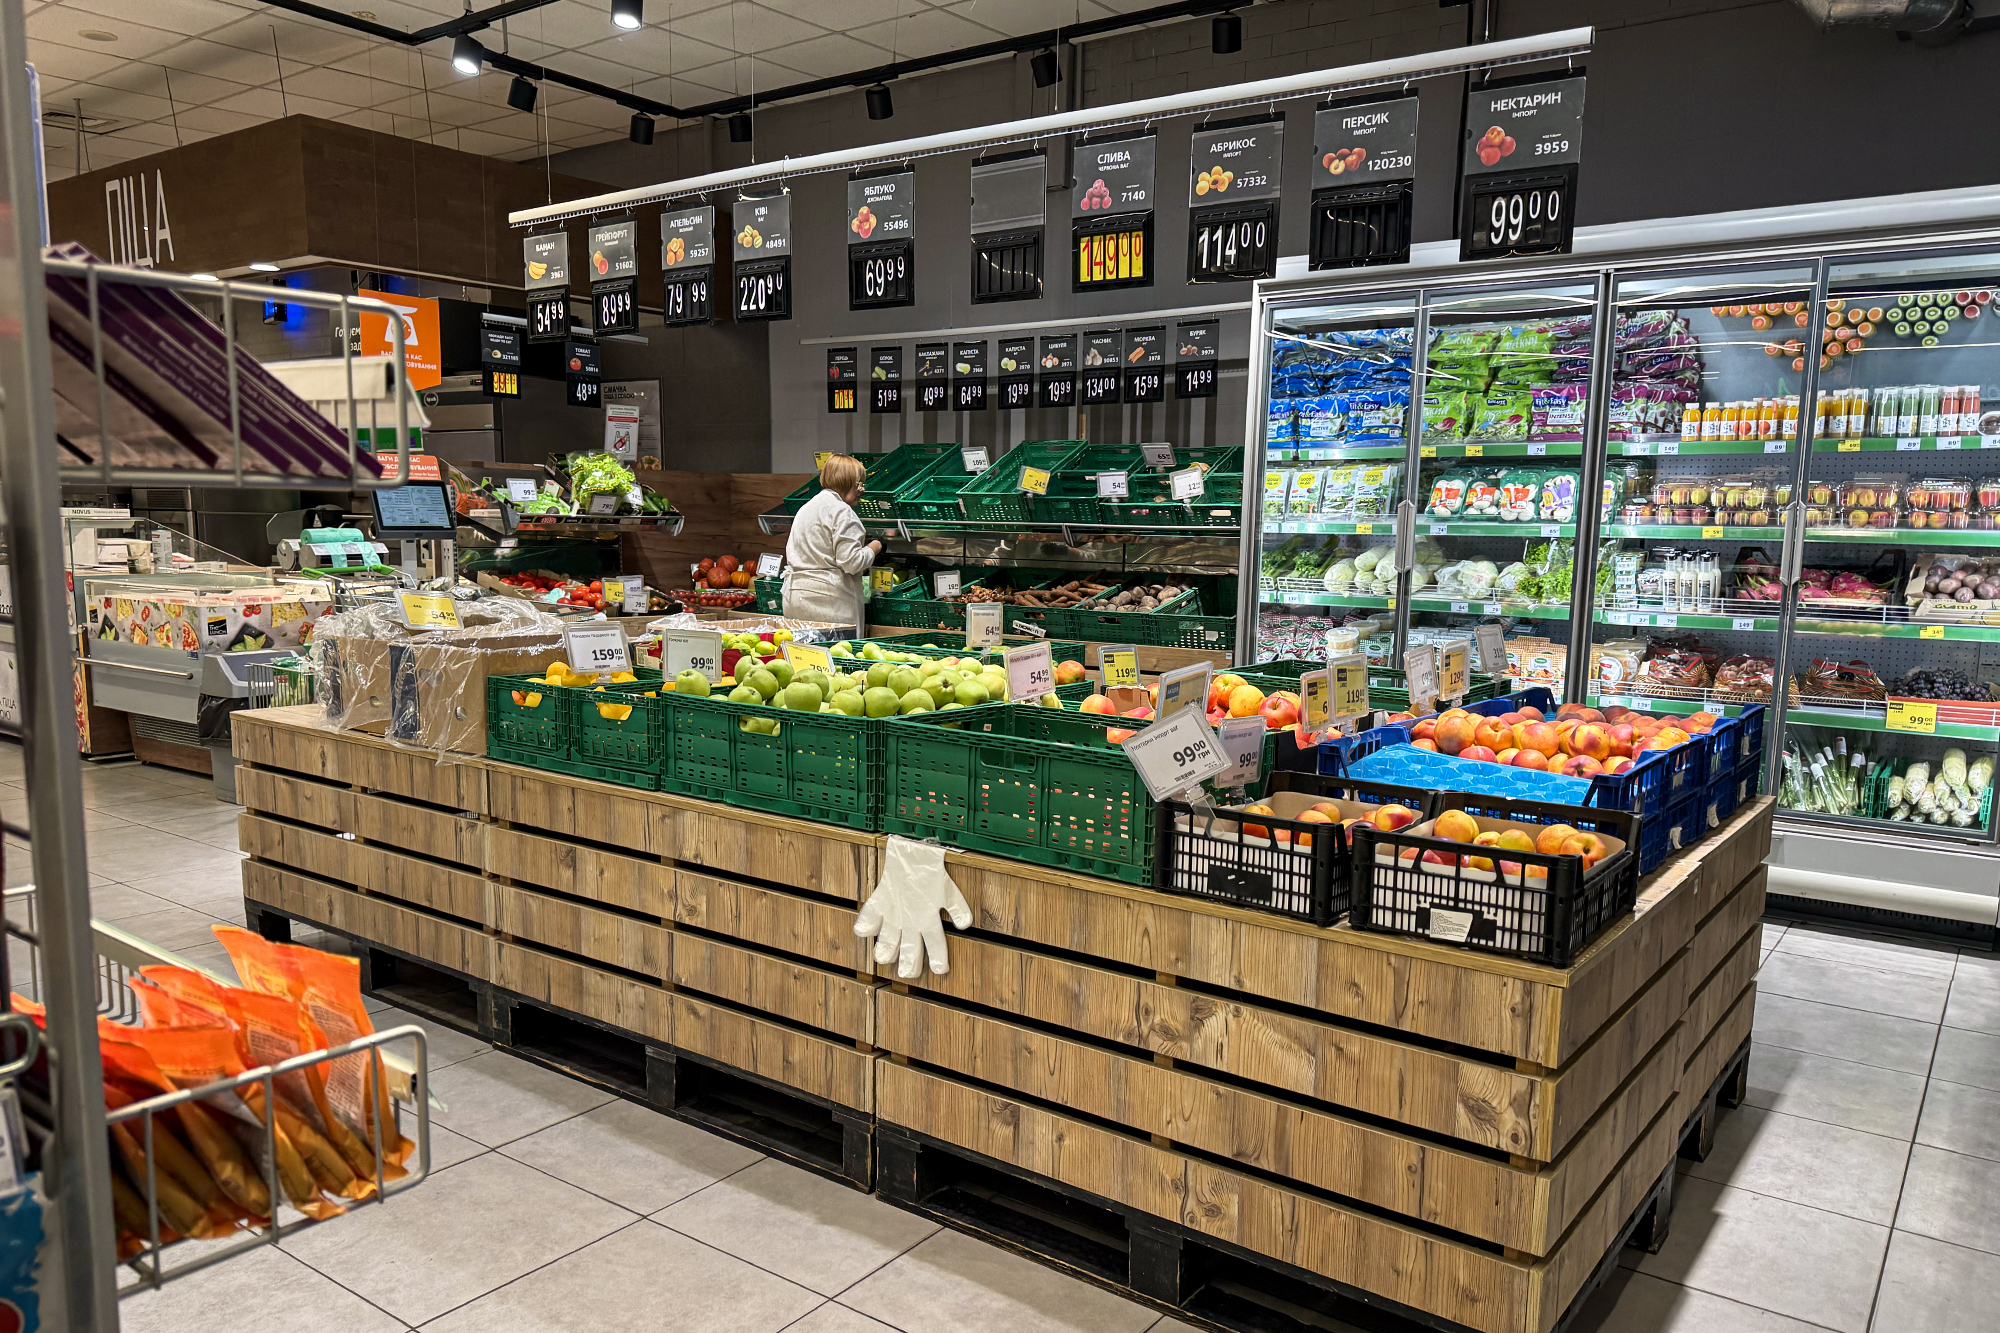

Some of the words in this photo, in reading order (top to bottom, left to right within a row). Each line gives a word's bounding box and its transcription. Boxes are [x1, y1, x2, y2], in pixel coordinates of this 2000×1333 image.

[1491, 92, 1562, 112] НЕКТАРИН
[1512, 109, 1537, 118] ІМПОРТ
[1343, 112, 1389, 129] ПЕРСИК
[1353, 127, 1376, 135] ІМПОРТ
[1210, 138, 1256, 153] АБРИКОС
[1534, 140, 1569, 155] 3959
[1097, 151, 1130, 164] СЛИВА
[1368, 155, 1412, 171] 120230
[1237, 176, 1266, 188] 57332
[864, 184, 895, 196] ЯБЛУКО
[1122, 190, 1145, 202] 7140
[755, 207, 767, 216] КІВІ
[106, 168, 174, 268] ПІЦА
[670, 215, 702, 228] АПЕЛЬСИН
[884, 220, 908, 231] 55496
[596, 230, 628, 242] ГРЕЙПФРУТ
[536, 242, 554, 252] БАНАН
[766, 238, 786, 249] 48491
[690, 248, 708, 258] 59257
[616, 261, 633, 270] 51602
[1131, 738, 1154, 751] Нектарин
[1198, 750, 1210, 759] грн
